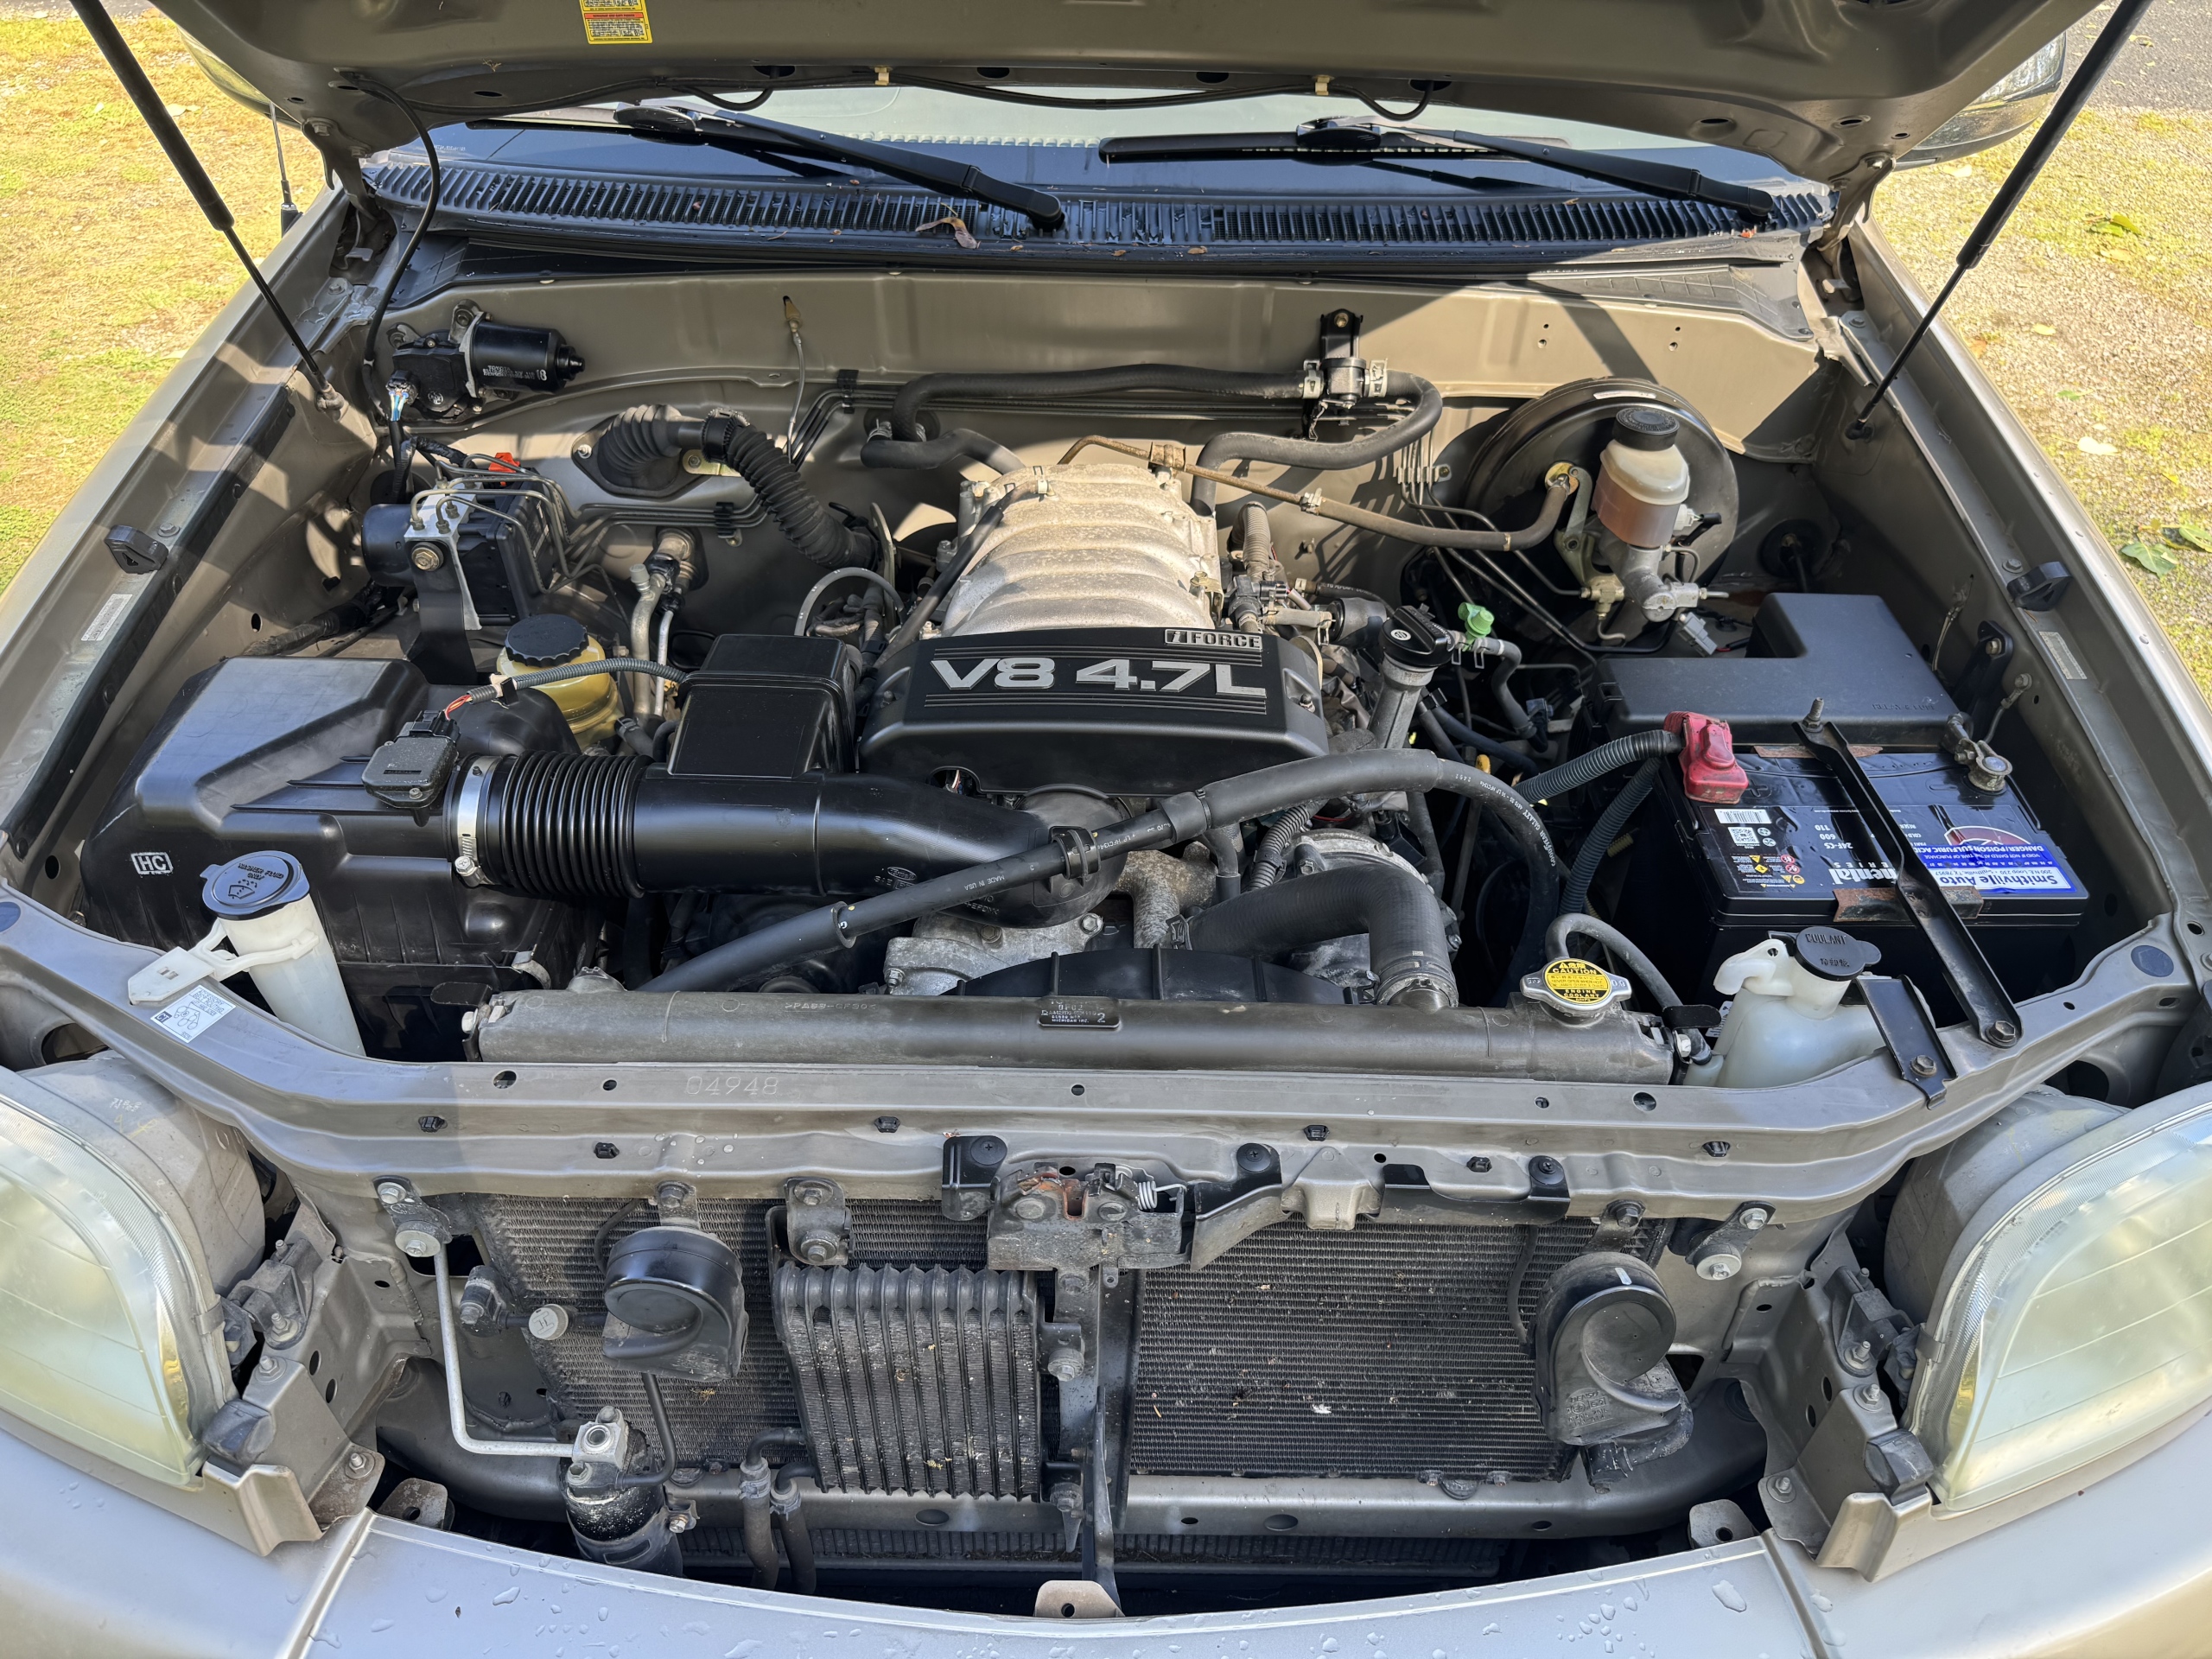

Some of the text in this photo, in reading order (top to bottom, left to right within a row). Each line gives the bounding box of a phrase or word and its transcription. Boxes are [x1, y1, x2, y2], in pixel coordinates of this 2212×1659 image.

[930, 658, 1268, 699] V8 4.7L
[1522, 809, 1541, 830] GALAXY
[137, 855, 167, 871] HC
[264, 870, 284, 880] FLUID
[986, 874, 1006, 886] MADE
[1828, 868, 1897, 885] nental
[1939, 874, 2058, 886] Smithville Auto
[963, 882, 977, 892] USA
[1805, 933, 1846, 944] COOLANT
[1096, 1012, 1106, 1023] 2
[685, 1076, 779, 1096] 04948
